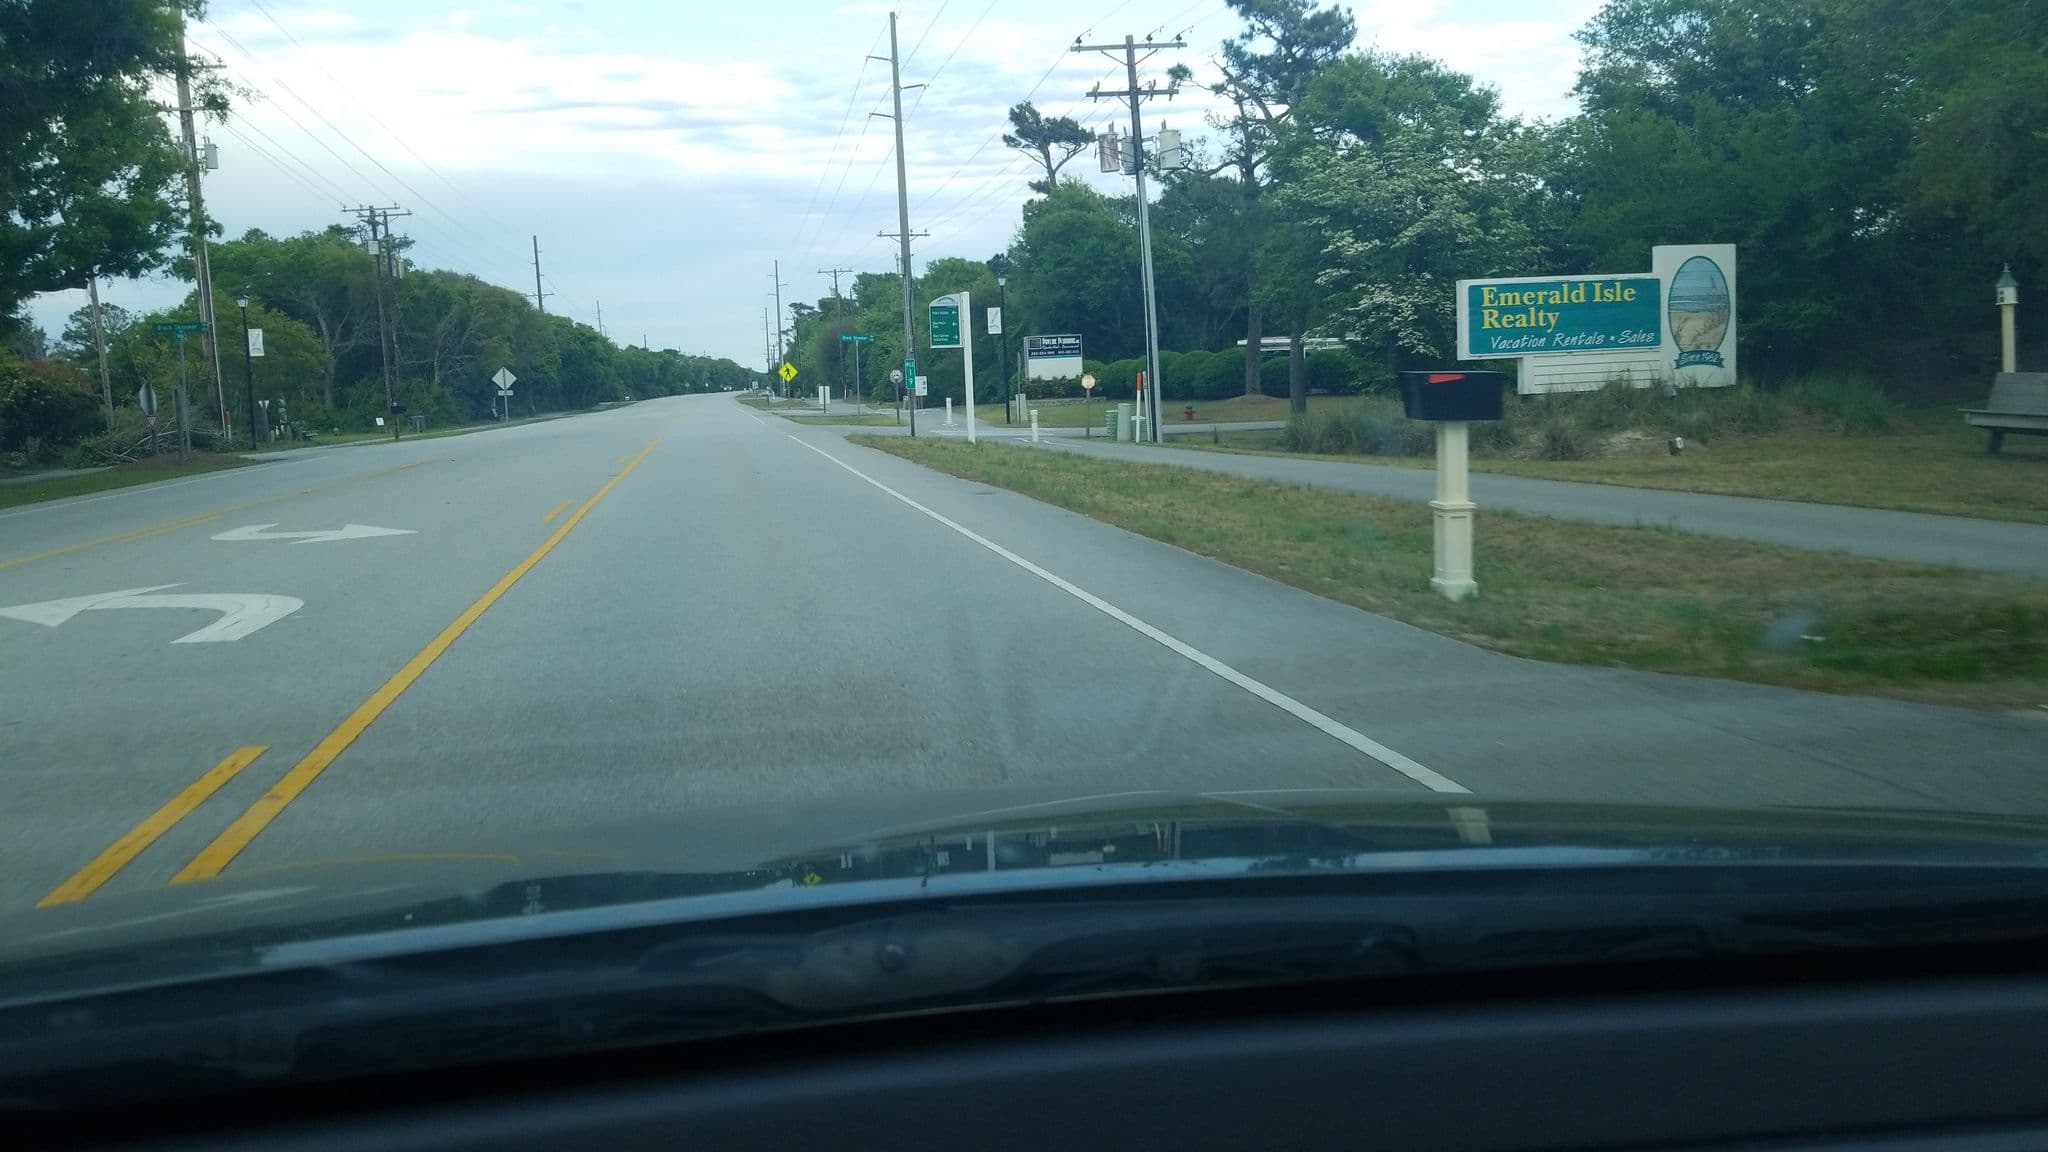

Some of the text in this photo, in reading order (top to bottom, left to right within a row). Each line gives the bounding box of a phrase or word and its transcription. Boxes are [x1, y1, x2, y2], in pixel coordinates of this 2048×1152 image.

[1481, 281, 1636, 307] Emerald Isle
[1481, 307, 1560, 333] Realty
[1491, 329, 1656, 349] Vacation Rentals Sales
